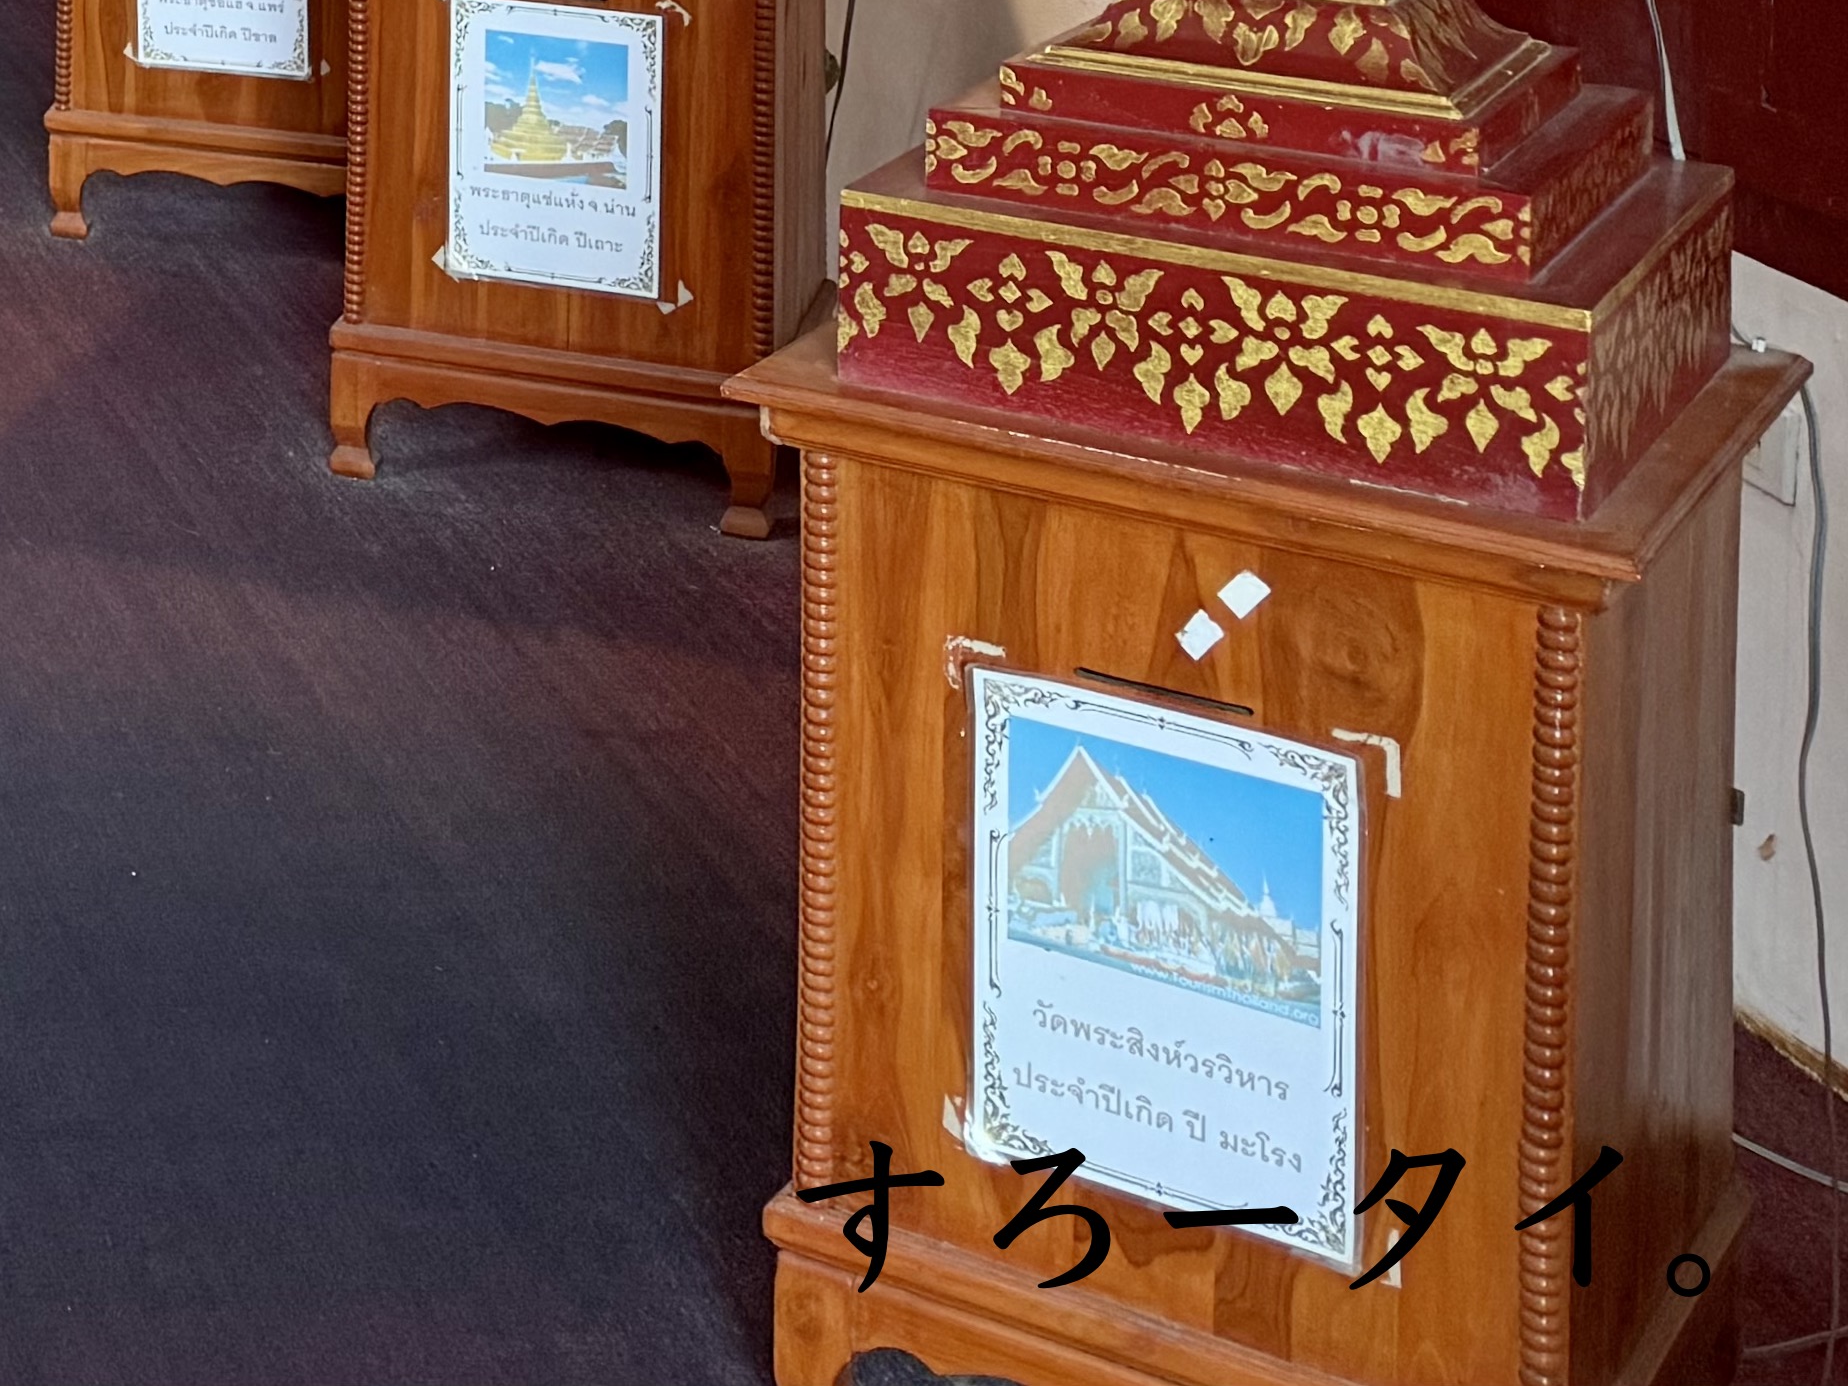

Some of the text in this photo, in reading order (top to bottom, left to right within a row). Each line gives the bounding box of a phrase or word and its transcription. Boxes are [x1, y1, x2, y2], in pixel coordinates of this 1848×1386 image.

[479, 219, 569, 247] ประจำปีเกิด
[1031, 999, 1290, 1102] วัดพระสิงห์วรวิหาร
[1012, 1061, 1174, 1134] ประจำปีเกิด
[1219, 1127, 1303, 1174] มะโรง
